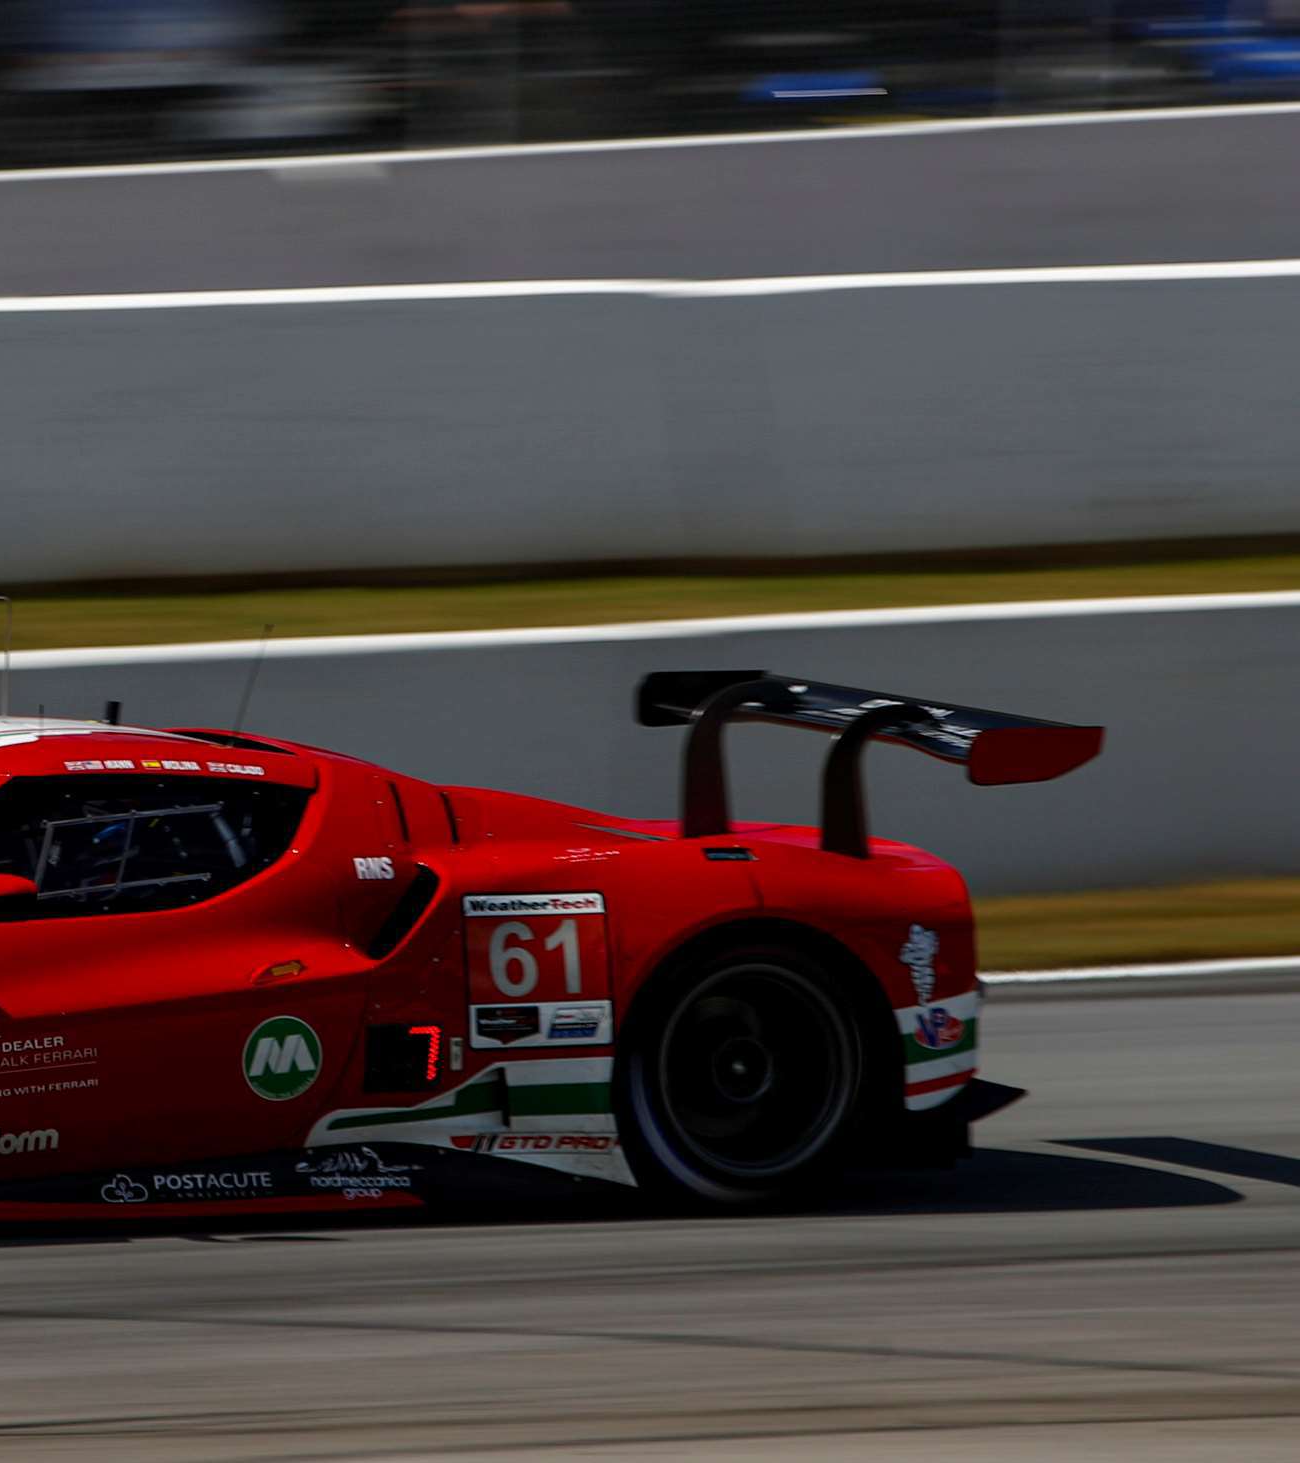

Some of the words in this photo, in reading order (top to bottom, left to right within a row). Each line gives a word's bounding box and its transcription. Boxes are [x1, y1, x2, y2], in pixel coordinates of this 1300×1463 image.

[469, 898, 598, 913] WeatherTech
[487, 918, 584, 998] 61
[2, 1035, 65, 1053] DEALER
[33, 1047, 99, 1065] FERRARI
[13, 1082, 47, 1096] WITH
[48, 1078, 100, 1093] FERRARI
[152, 1171, 274, 1191] POSTACUTE
